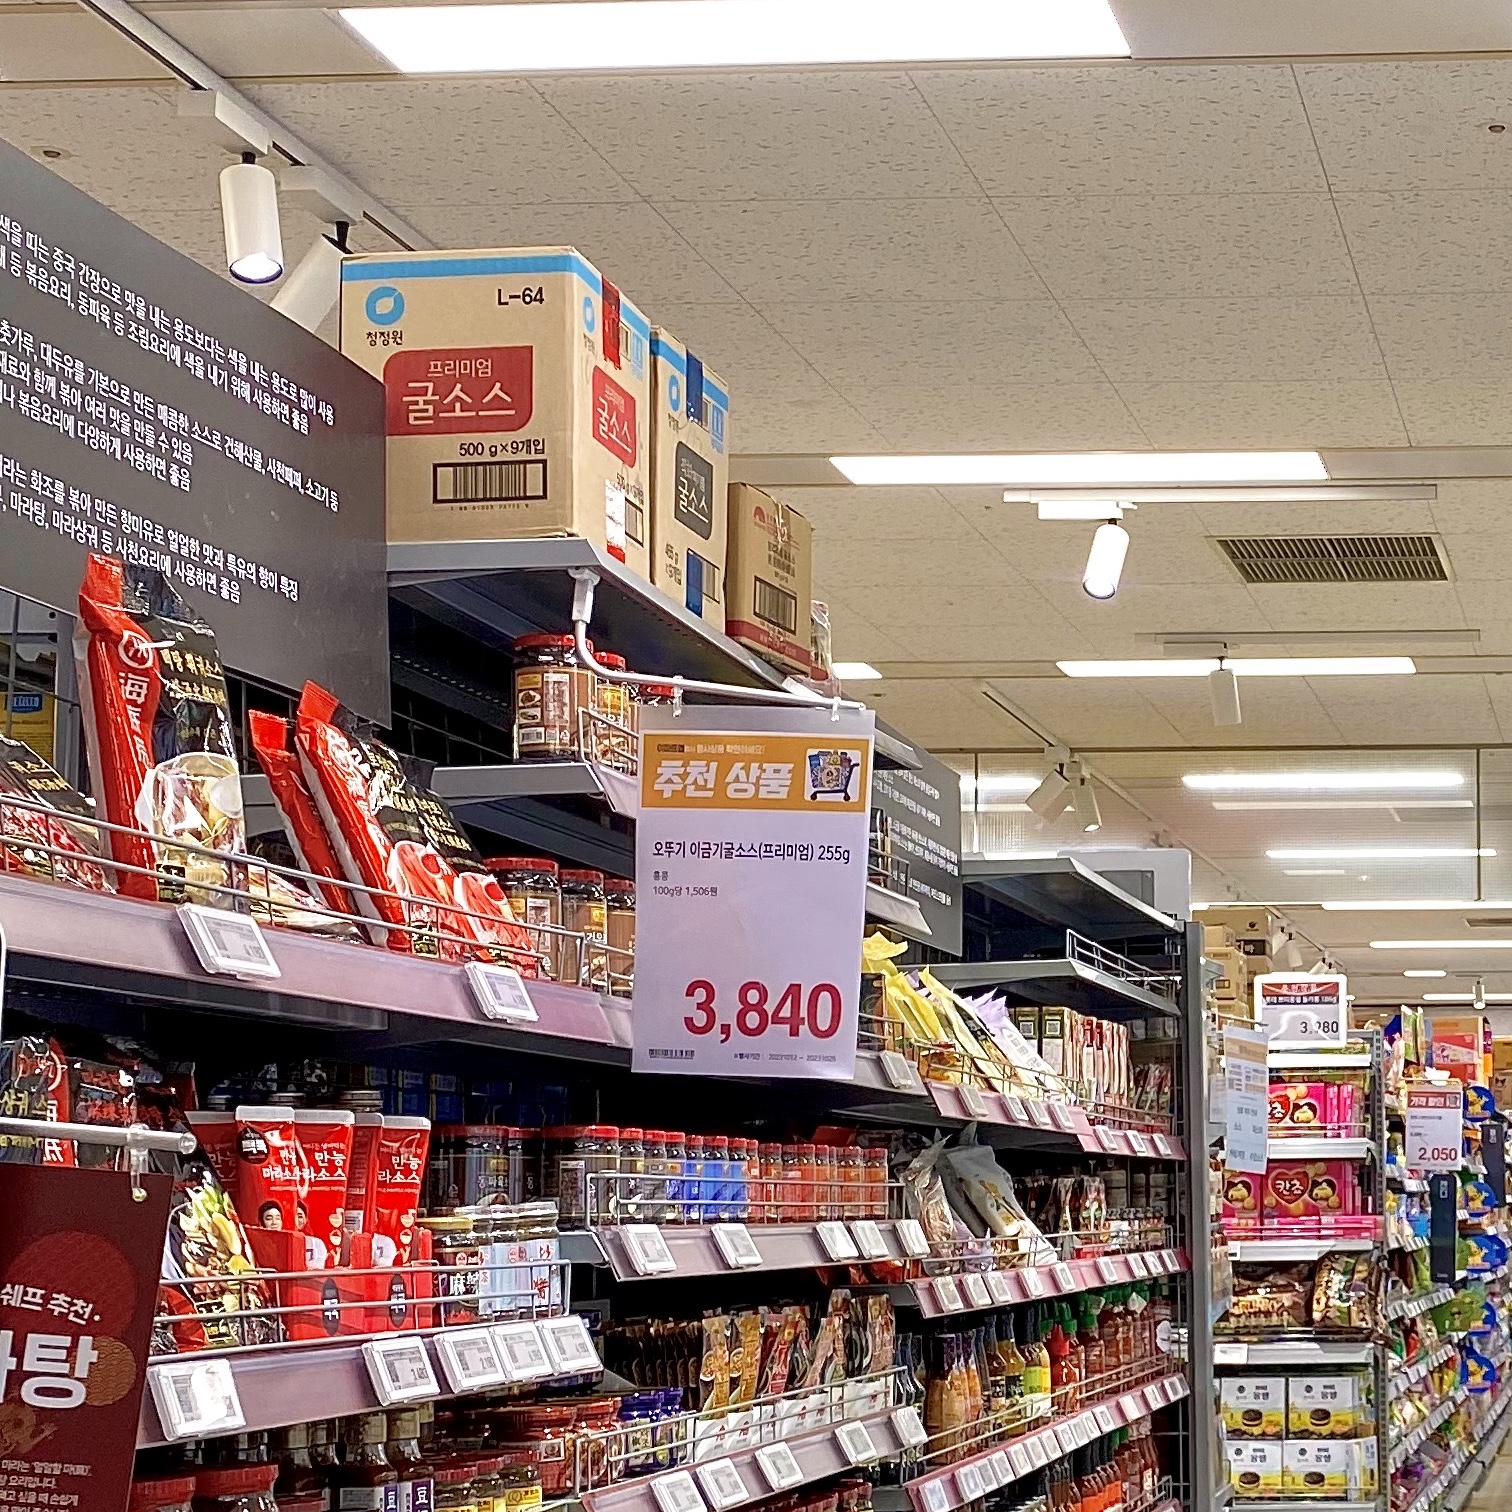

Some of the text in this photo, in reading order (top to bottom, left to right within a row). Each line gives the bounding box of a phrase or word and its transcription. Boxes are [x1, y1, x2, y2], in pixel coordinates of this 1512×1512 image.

[496, 286, 545, 306] L-64
[0, 215, 22, 247] 색을
[26, 231, 50, 263] 띠는
[52, 247, 75, 280] 중국
[78, 262, 123, 305] 간장으로
[124, 290, 146, 320] 맛을
[149, 305, 171, 334] 내는
[173, 317, 226, 363] 용도보다는
[227, 347, 248, 376] 색을
[249, 361, 269, 387] 내는
[271, 371, 298, 402] 용도로
[299, 388, 316, 415] 많이
[318, 401, 334, 426] 사용
[366, 330, 403, 346] 청정원
[10, 251, 22, 278] 등
[25, 260, 75, 310] 볶음요리,
[77, 290, 112, 329] 동파육
[113, 312, 125, 337] 등
[126, 320, 182, 367] 조림요리에
[183, 350, 205, 380] 색을
[207, 363, 228, 393] 내기
[230, 375, 250, 404] 위해
[252, 388, 290, 425] 사용하면
[290, 407, 309, 436] 좋음
[426, 357, 493, 378] 프리미엄
[33, 367, 56, 400] 함께
[58, 381, 83, 412] 볶아
[84, 395, 107, 426] 여러
[109, 406, 131, 437] 맛을
[133, 419, 156, 449] 만들
[157, 431, 171, 454] 수
[171, 437, 193, 467] 있음
[401, 381, 517, 426] 굴소스
[596, 396, 633, 454] 굴소스
[18, 389, 191, 493] 볶음요리에 다양하게 사용하면 좋음
[40, 342, 86, 385] 대두유를
[87, 367, 132, 407] 기본으로
[133, 390, 155, 421] 만든
[157, 403, 189, 437] 매콤한
[190, 421, 223, 452] 소스로
[329, 490, 339, 513] 등
[459, 443, 485, 457] 500
[678, 475, 711, 524] 굴소스
[10, 491, 50, 529] 마라탕,
[52, 510, 99, 549] 마라샹궈
[101, 529, 114, 555] 등
[115, 536, 172, 578] 사천요리에
[174, 560, 218, 595] 사용하면
[219, 576, 241, 604] 좋음
[30, 469, 66, 506] 화조를
[68, 486, 92, 517] 볶아
[94, 498, 118, 528] 만든
[120, 509, 166, 546] 향미유로
[166, 529, 200, 562] 얼얼한
[202, 543, 224, 571] 맛과
[226, 553, 257, 585] 특유의
[258, 566, 278, 593] 향이
[279, 575, 299, 602] 특징
[653, 760, 794, 799] 추천 상품
[653, 841, 850, 864] 오뚜기 이금기굴소스(프리미엄) 255g
[653, 886, 718, 897] 100g당 1,506원
[683, 979, 841, 1044] 3,840
[314, 1150, 347, 1168] 만능
[390, 1155, 423, 1171] 만능
[1418, 1147, 1459, 1163] 2,050
[0, 1283, 94, 1325] 쉐프 추천
